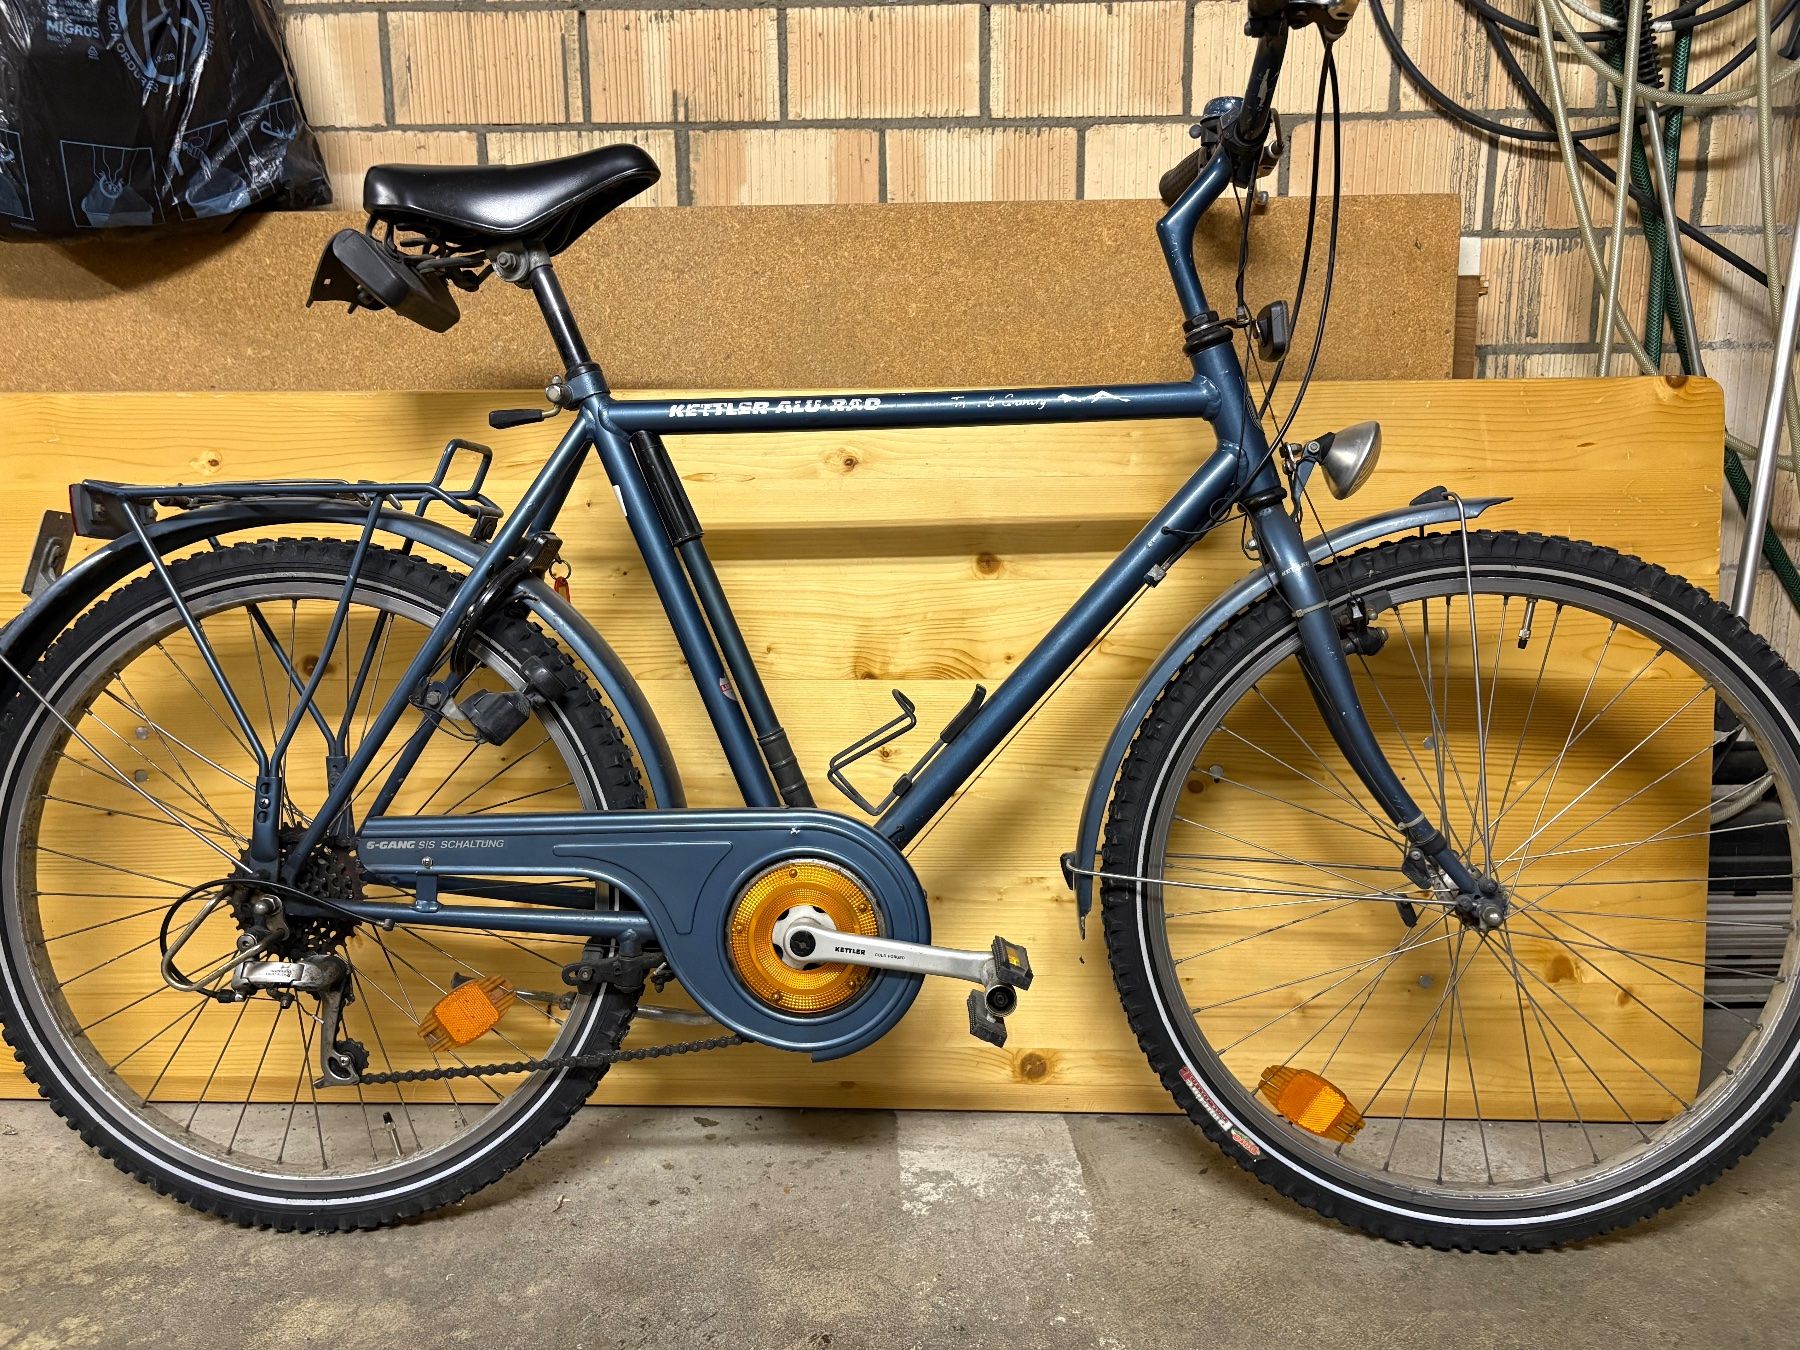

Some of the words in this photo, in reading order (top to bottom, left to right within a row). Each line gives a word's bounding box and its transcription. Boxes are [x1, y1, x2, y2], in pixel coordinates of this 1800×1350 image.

[201, 0, 215, 34] RIFIU
[46, 19, 100, 39] MIGROS
[668, 402, 770, 418] KETTLER
[440, 839, 505, 849] SCHALTUNG
[834, 946, 866, 956] KETTLER
